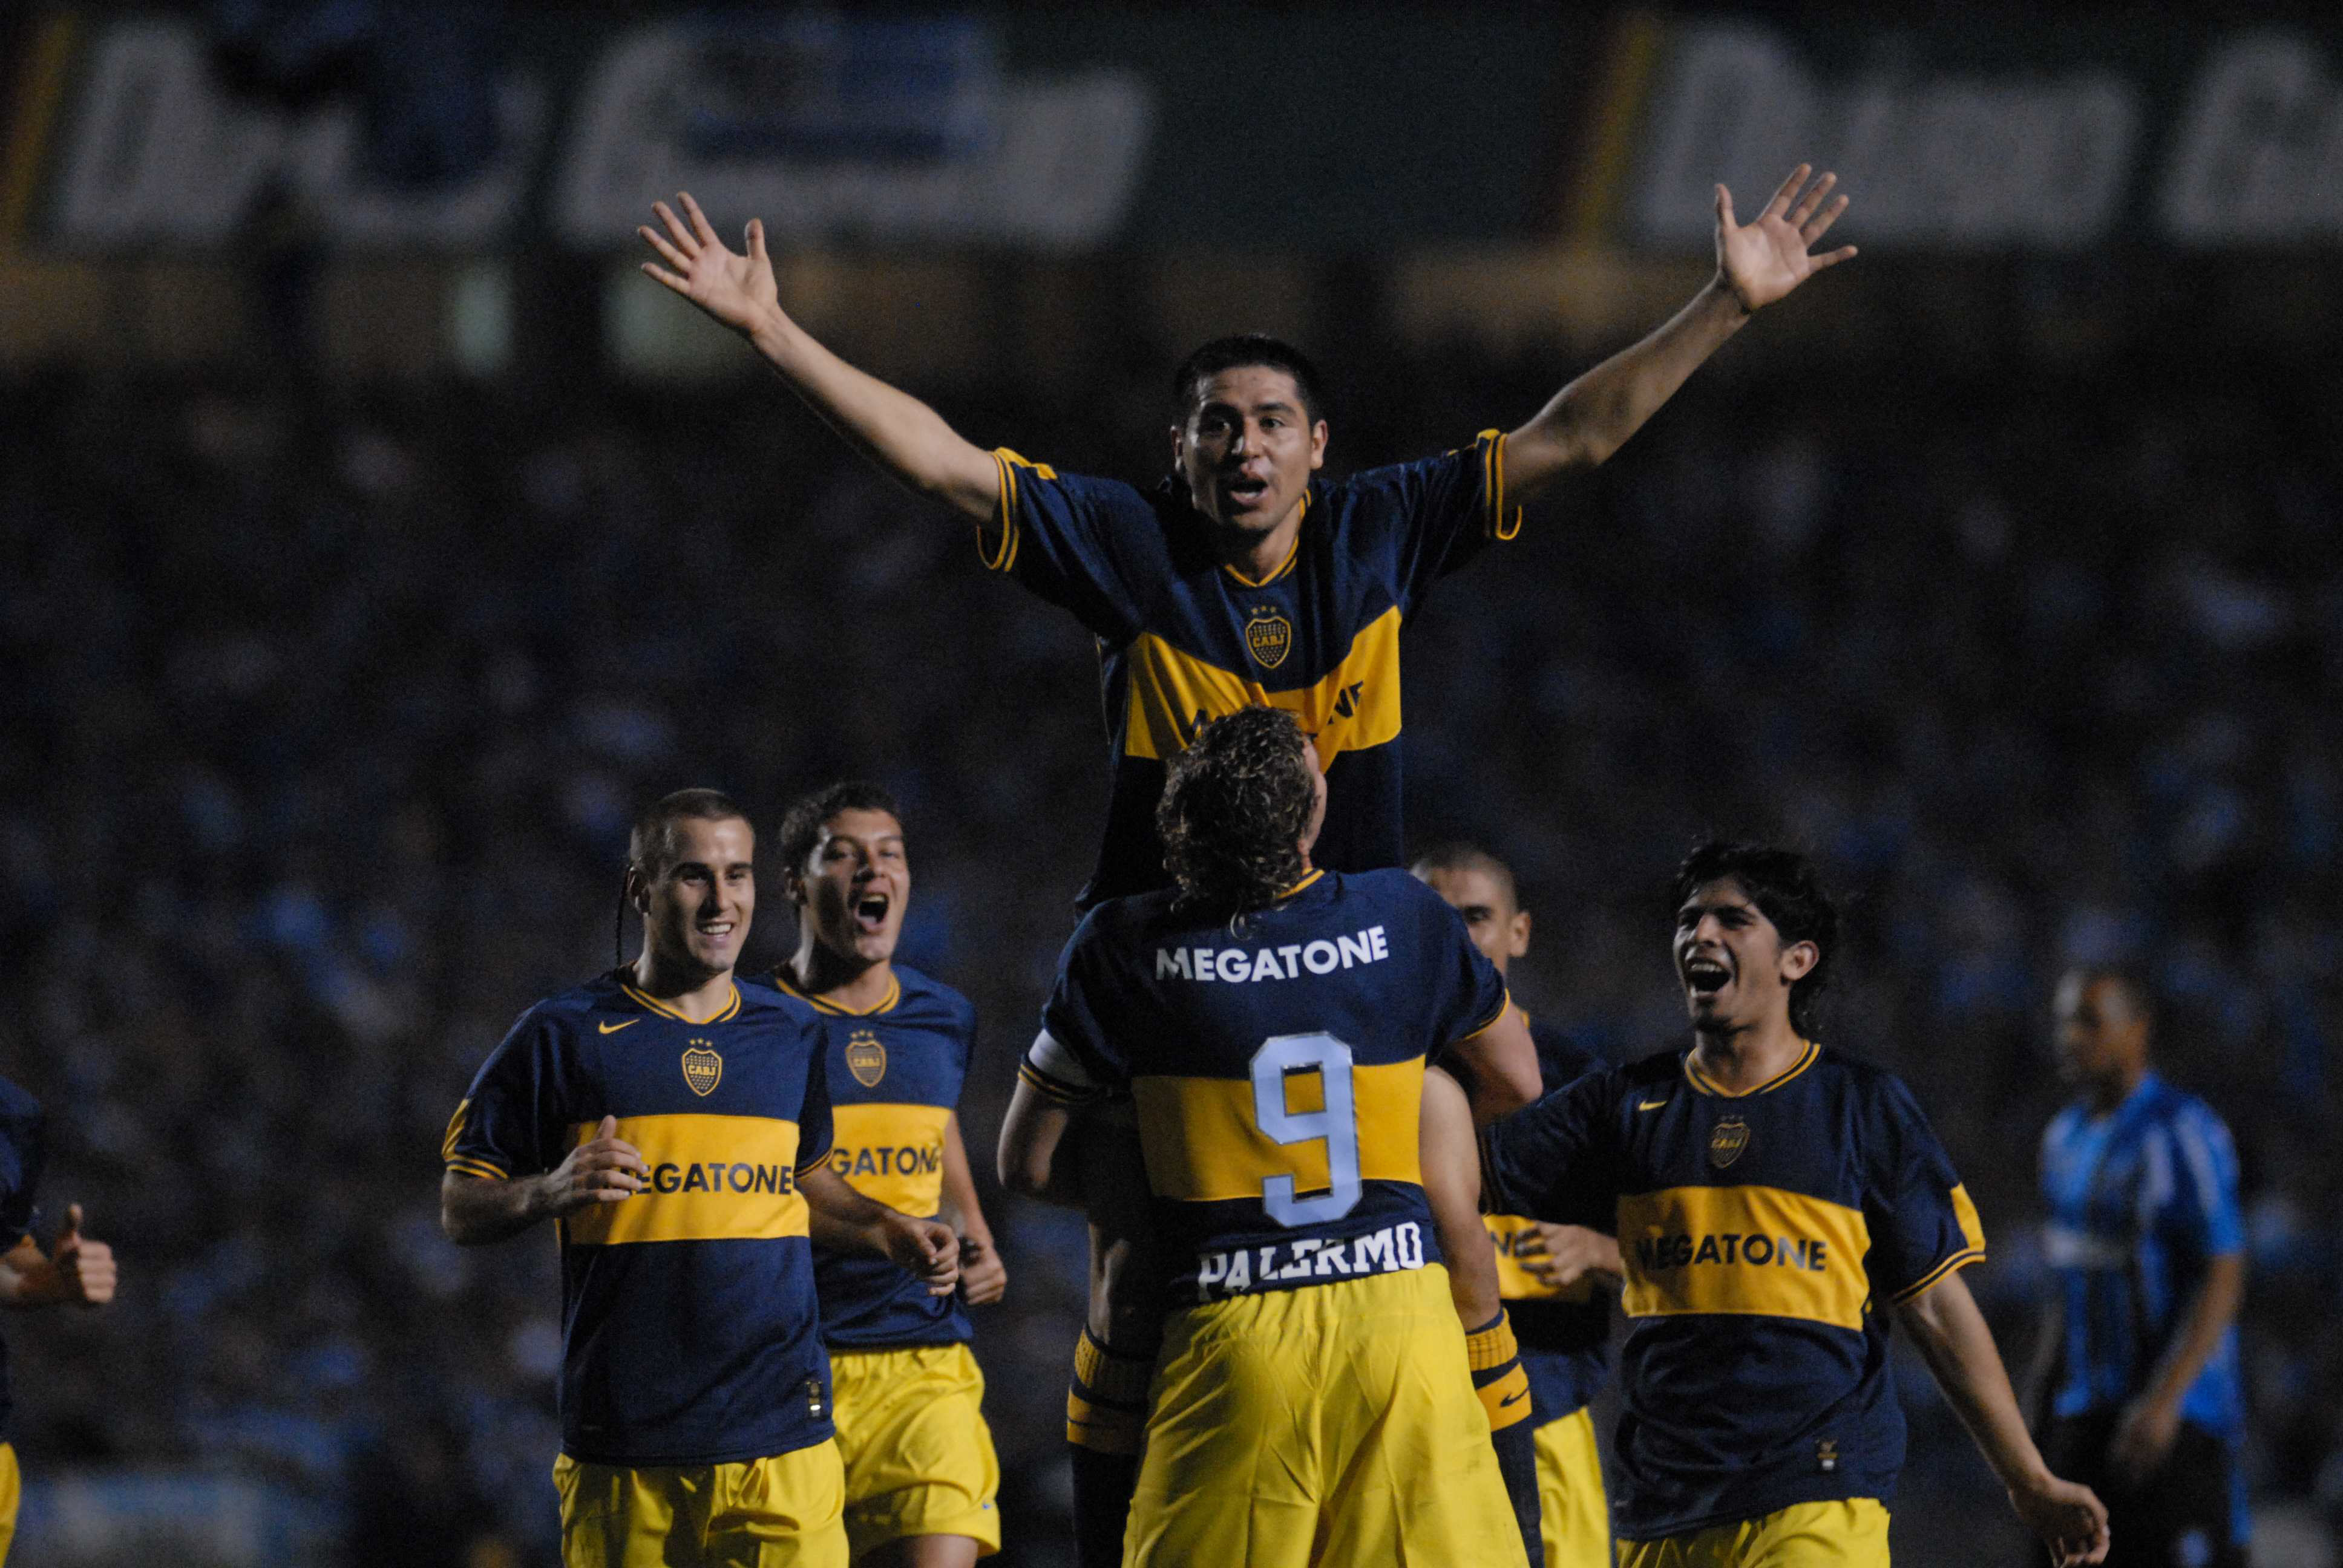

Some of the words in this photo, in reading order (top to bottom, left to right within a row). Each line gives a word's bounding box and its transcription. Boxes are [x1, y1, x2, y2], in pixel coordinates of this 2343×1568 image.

[1253, 633, 1285, 648] CABJ
[1156, 926, 1389, 982] MEGATONE
[688, 1065, 716, 1076] CABJ
[1249, 1030, 1363, 1229] 9
[826, 1146, 939, 1177] GATON
[620, 1163, 791, 1196] EGATONE
[1198, 1221, 1424, 1302] PALERMO
[1636, 1233, 1826, 1271] MEGATONE
